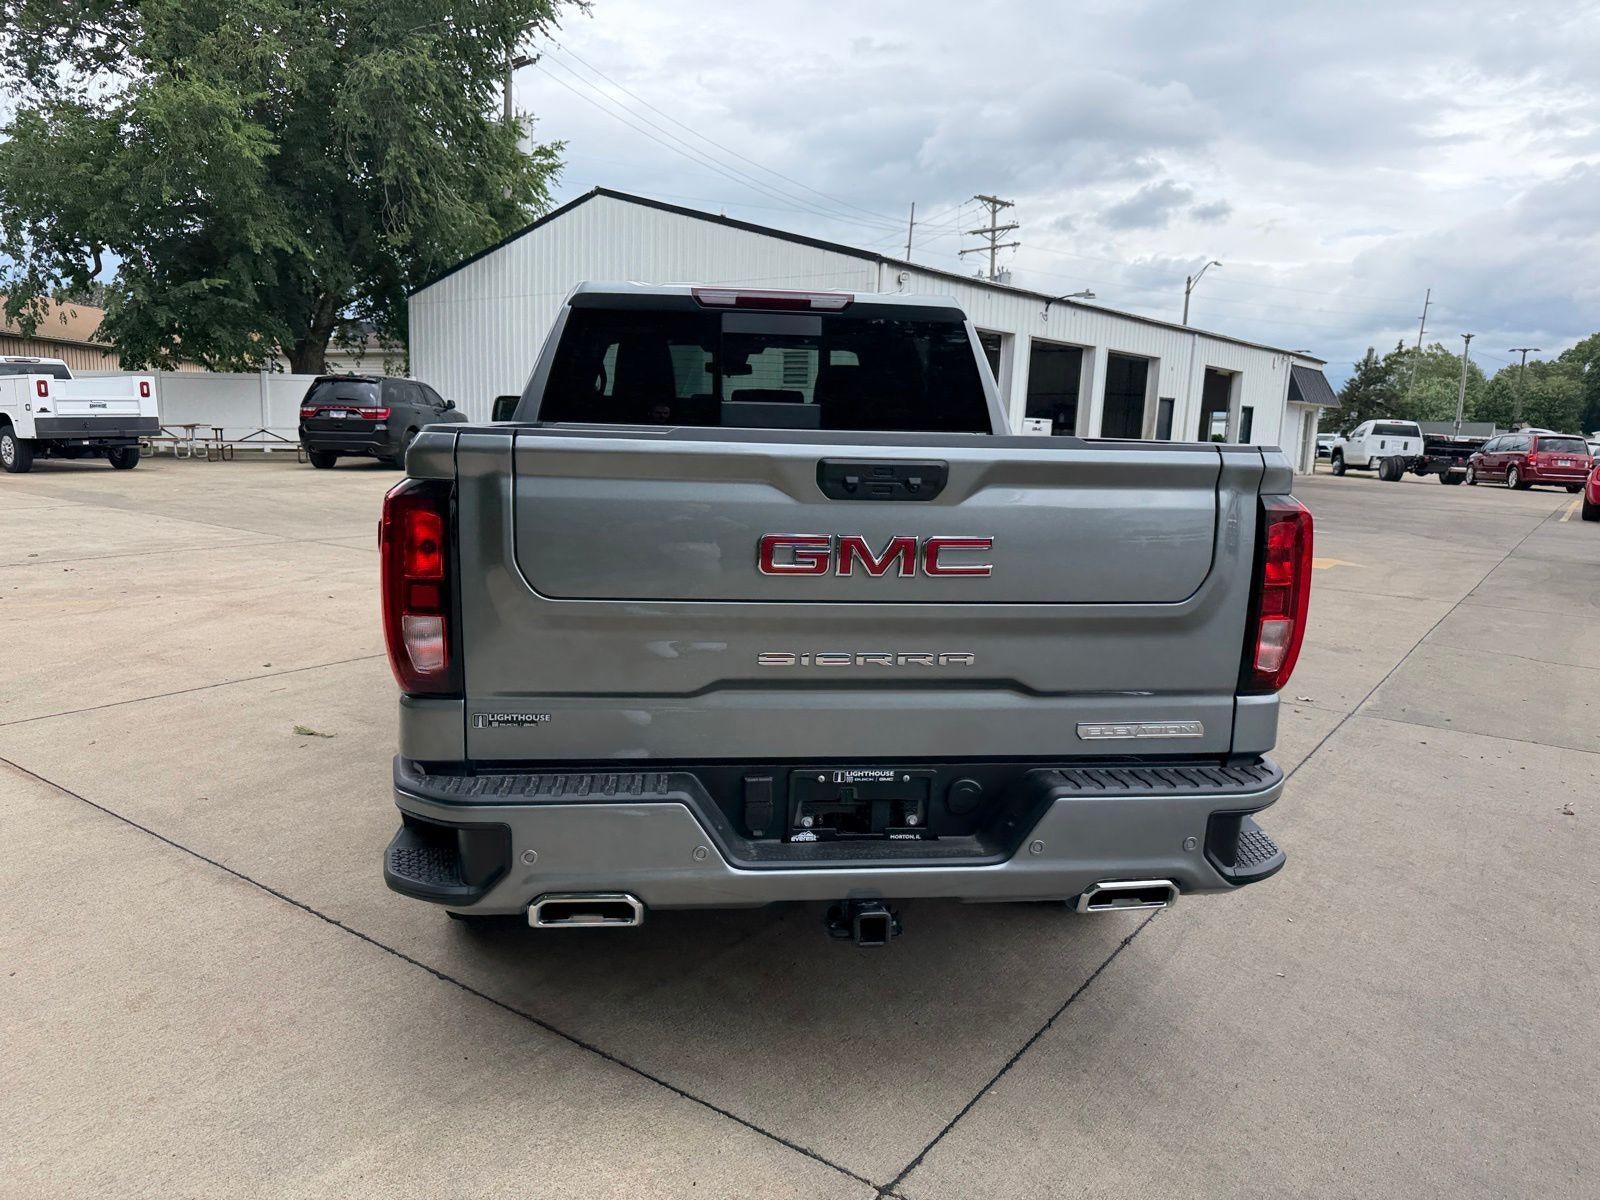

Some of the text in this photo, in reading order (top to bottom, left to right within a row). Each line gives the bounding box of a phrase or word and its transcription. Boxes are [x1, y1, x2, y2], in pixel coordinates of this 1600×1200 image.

[758, 532, 995, 578] GMC
[758, 652, 976, 666] SIERRA
[489, 713, 551, 721] LIGHTHOUSE
